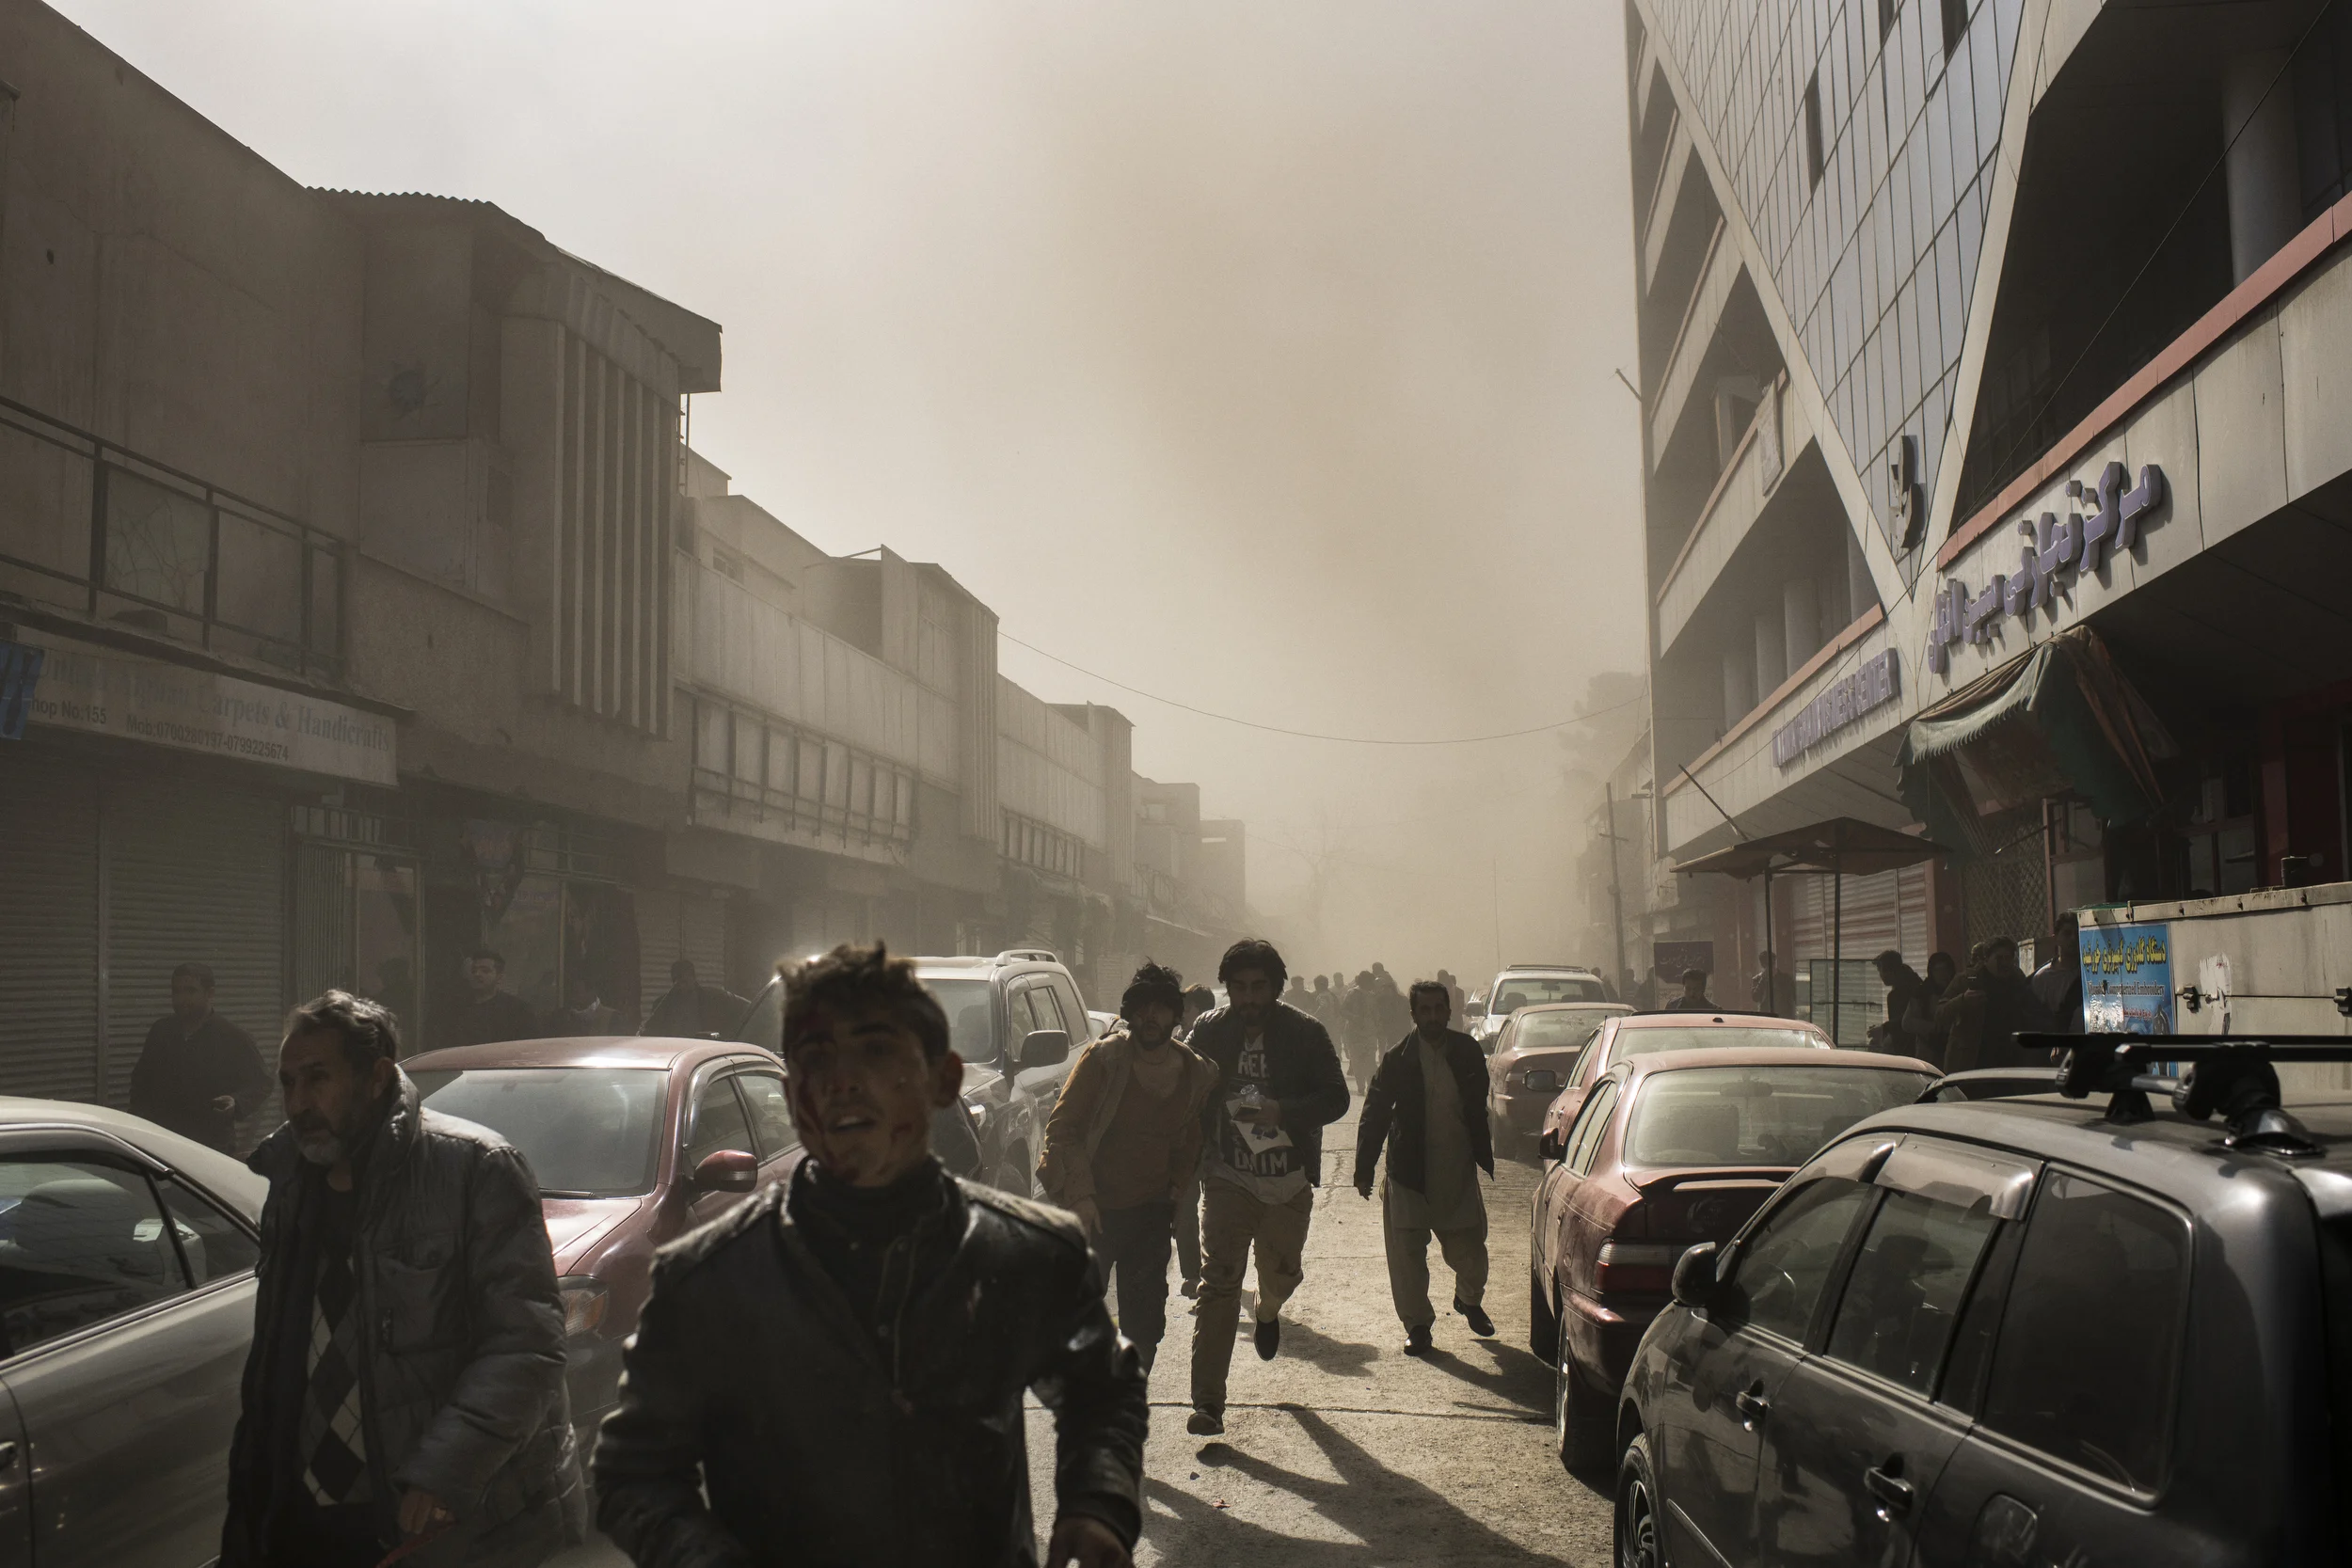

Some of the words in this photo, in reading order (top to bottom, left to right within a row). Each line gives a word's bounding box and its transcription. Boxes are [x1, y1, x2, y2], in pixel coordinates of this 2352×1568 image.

[32, 698, 57, 719] hop
[199, 683, 269, 728] Carpets
[275, 702, 290, 730] &
[297, 705, 389, 752] Handicrafts
